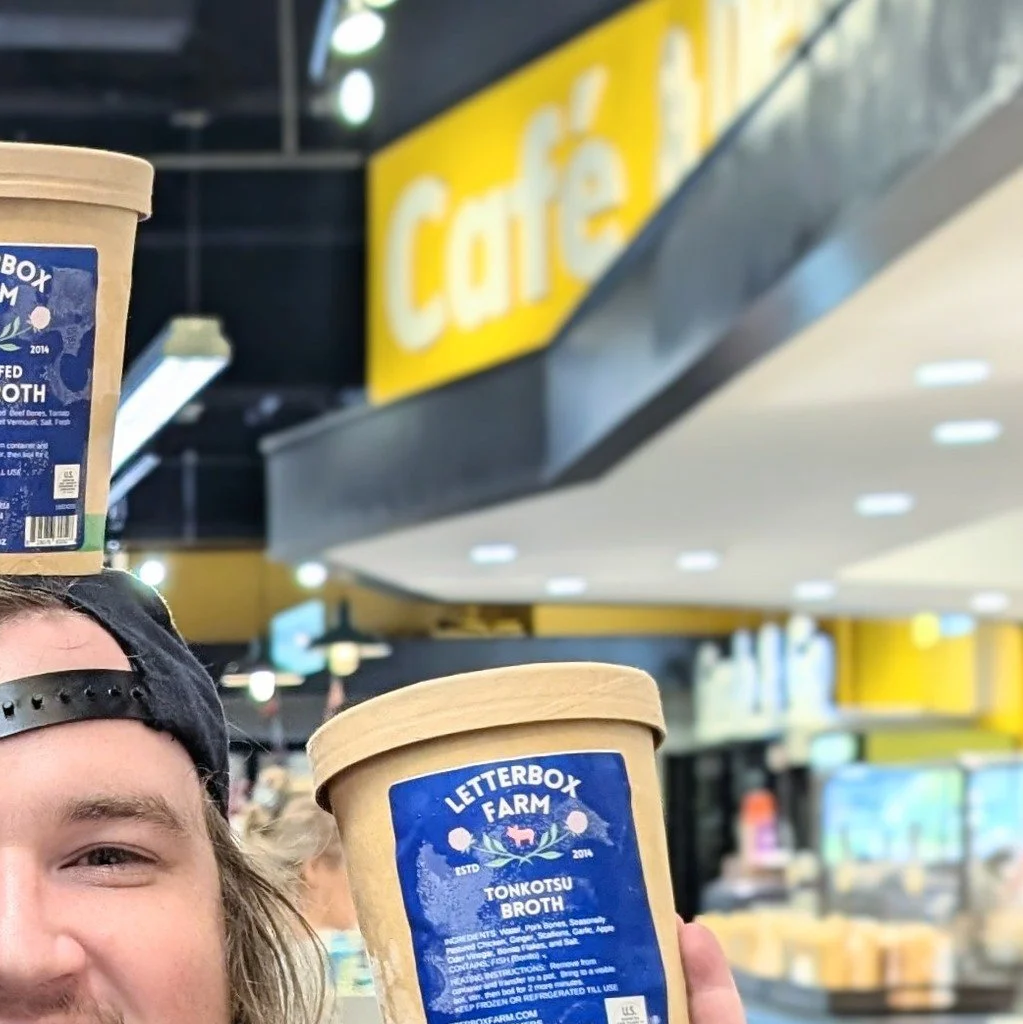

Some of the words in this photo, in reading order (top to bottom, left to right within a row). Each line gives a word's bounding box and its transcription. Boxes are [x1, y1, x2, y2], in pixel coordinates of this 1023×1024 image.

[385, 64, 628, 354] Café
[30, 345, 49, 354] 2014
[444, 764, 582, 814] LETTERBOX
[481, 793, 550, 822] FARM
[572, 849, 594, 860] 2014
[454, 864, 480, 876] ESTD
[484, 877, 573, 900] TONKOTSU
[500, 898, 564, 919] BROTH
[509, 996, 522, 1004] OR
[586, 986, 602, 994] TILL
[622, 1006, 636, 1016] U.S.
